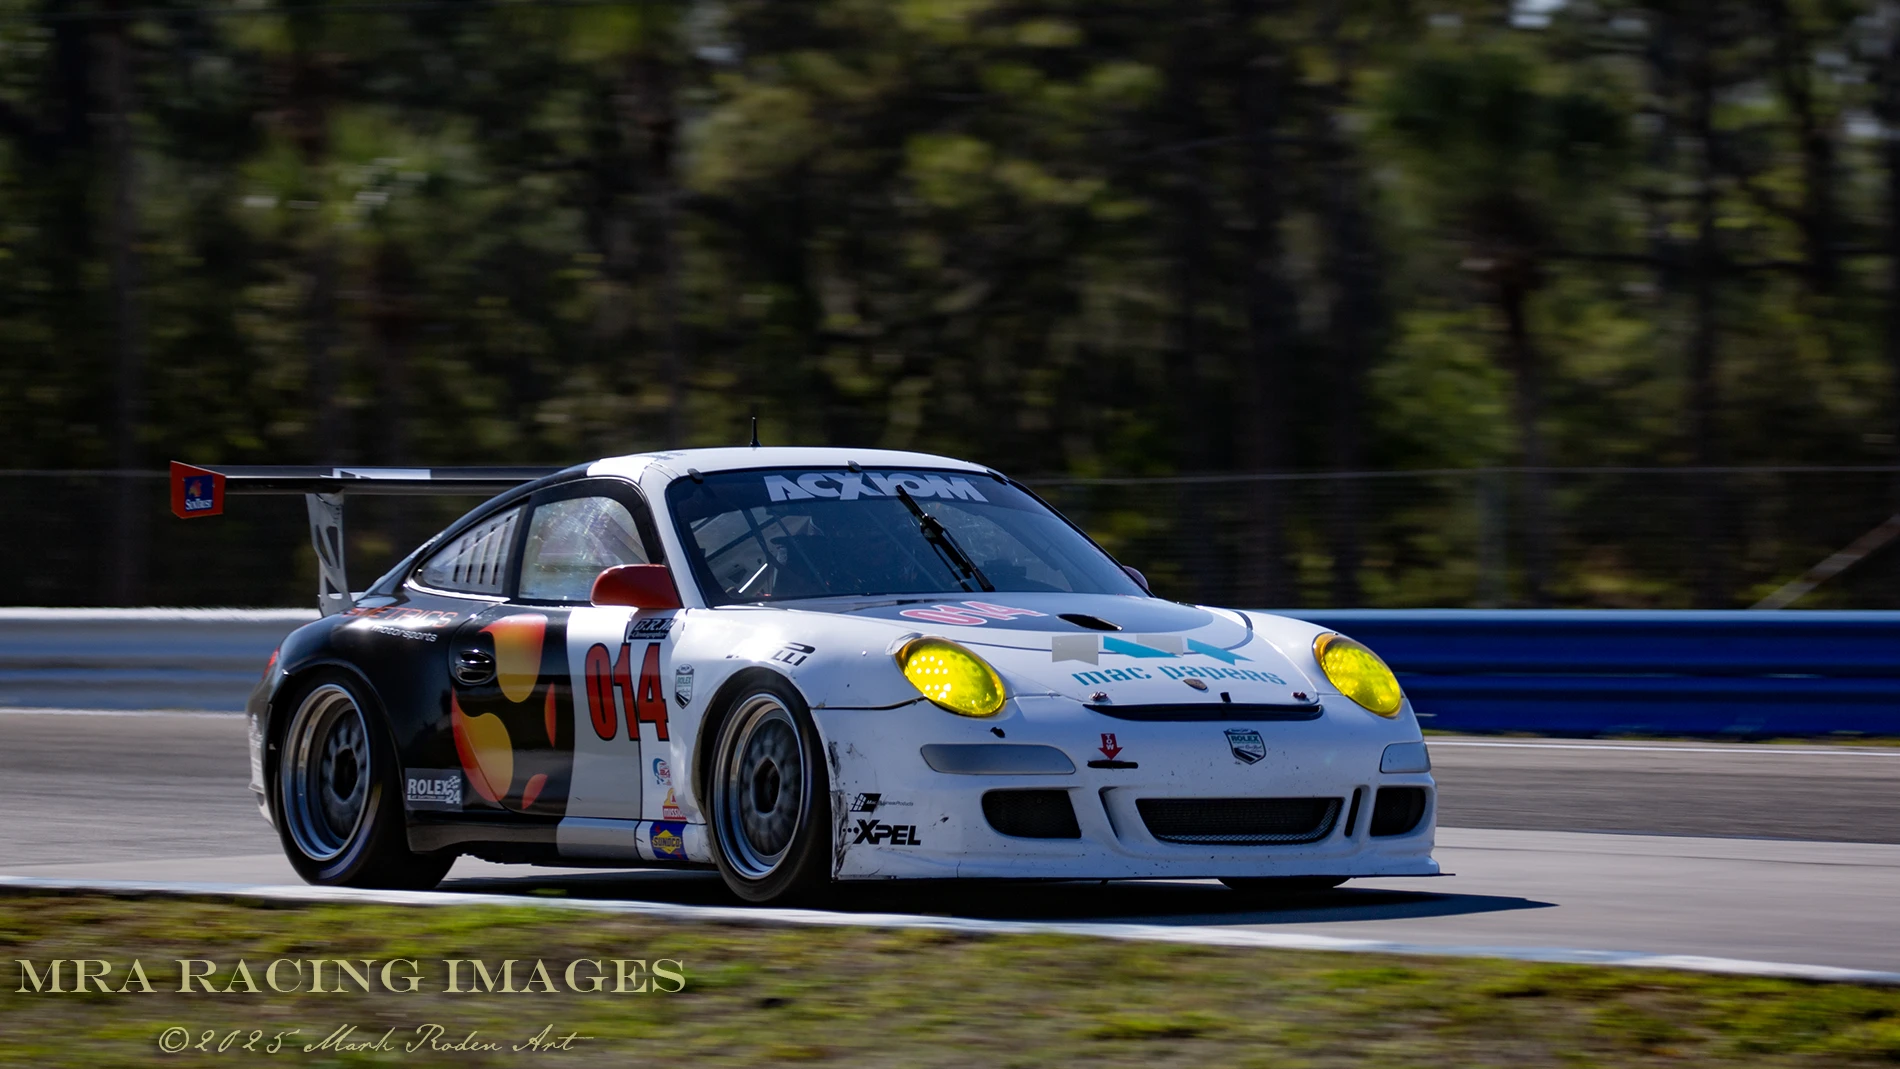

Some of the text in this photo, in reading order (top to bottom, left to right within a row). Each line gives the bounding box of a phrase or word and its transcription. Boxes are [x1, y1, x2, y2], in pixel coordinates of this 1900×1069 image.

[763, 472, 989, 502] ACXIOM
[900, 601, 1049, 626] 014
[371, 624, 438, 642] motorsports
[1071, 665, 1288, 686] mac papers
[585, 642, 670, 741] 014
[1105, 734, 1114, 750] TOW
[407, 779, 449, 795] ROLEX
[446, 789, 461, 804] 24
[852, 819, 921, 845] XPEL
[653, 836, 681, 848] SUNOCO
